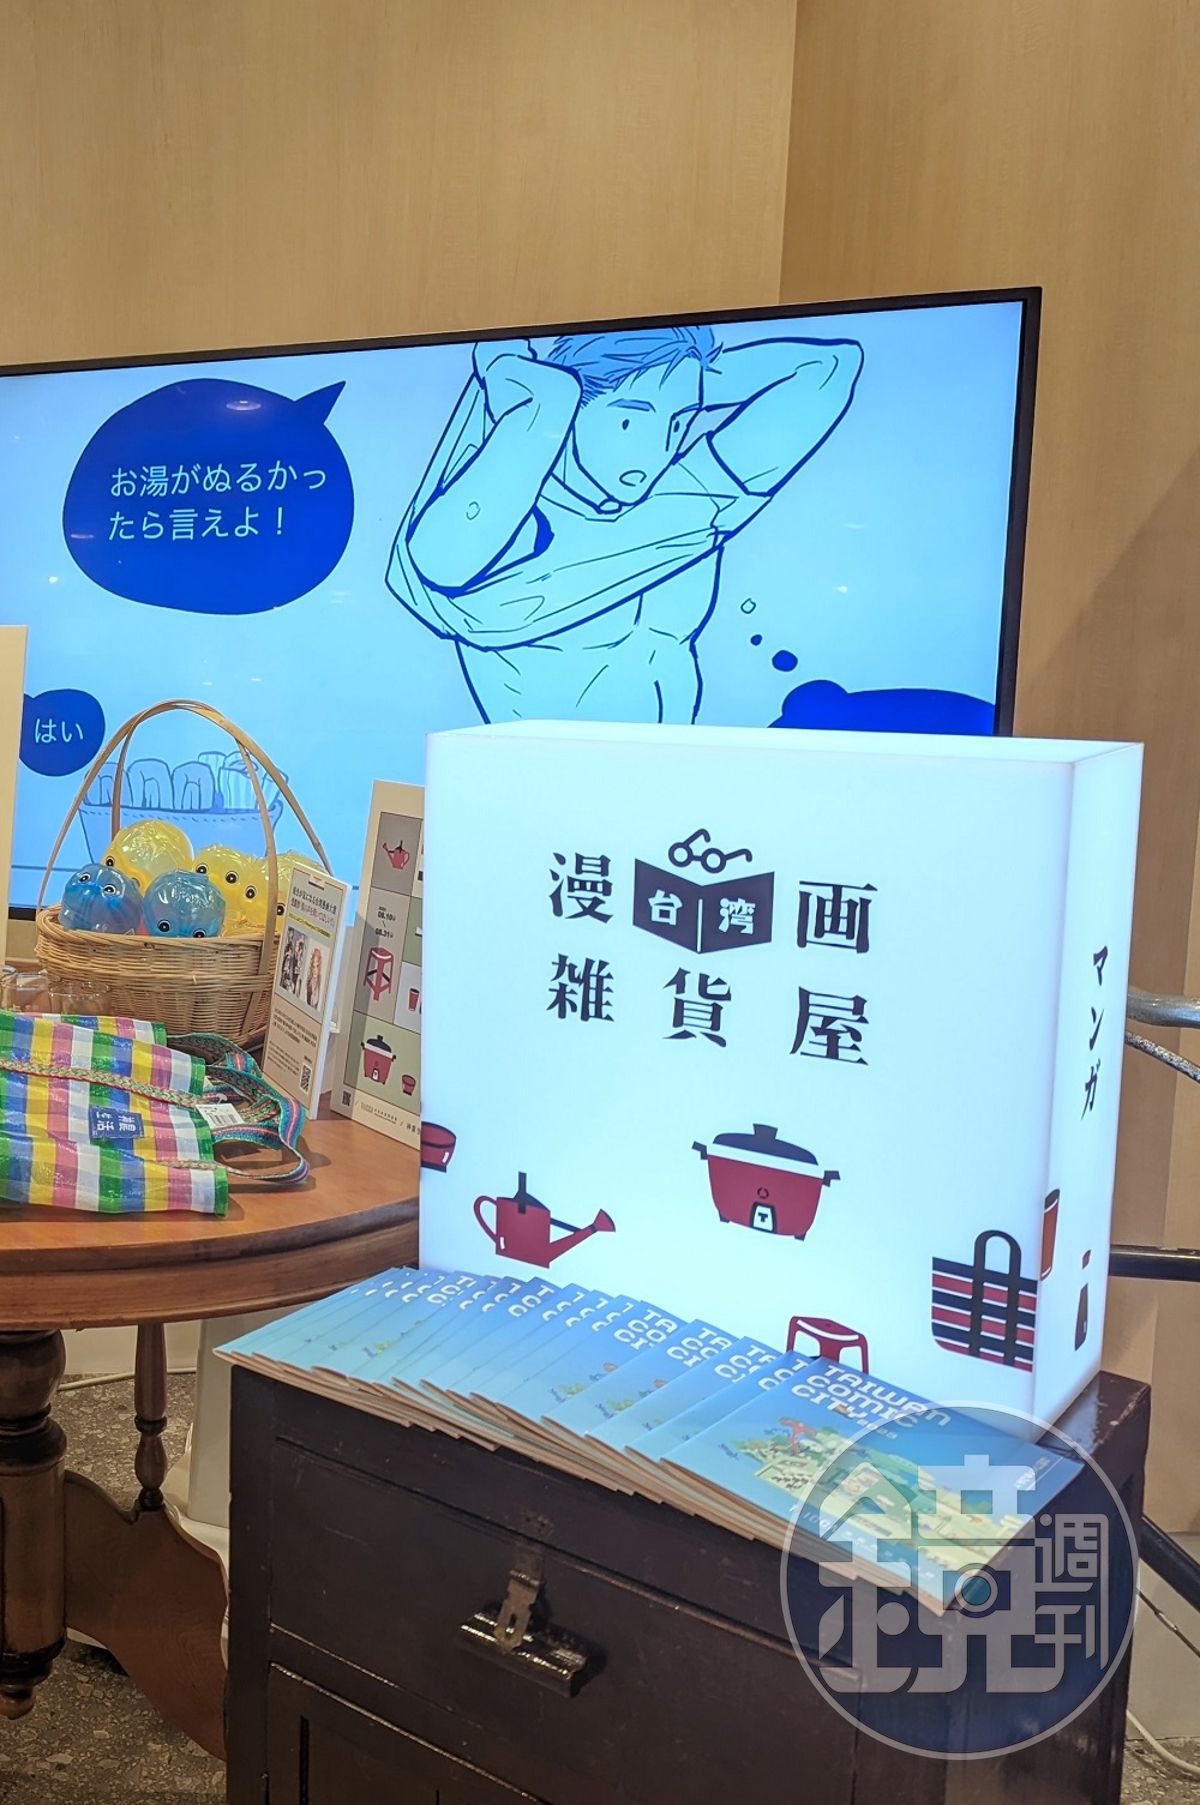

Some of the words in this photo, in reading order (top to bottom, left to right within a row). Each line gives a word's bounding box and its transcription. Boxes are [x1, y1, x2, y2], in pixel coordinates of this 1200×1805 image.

[109, 460, 327, 498] お湯がぬるかっ
[108, 507, 284, 542] たら言えよ！
[34, 717, 85, 745] はい
[648, 889, 756, 935] 台湾
[1081, 945, 1108, 1121] マンガ
[791, 1384, 868, 1418] CITY
[806, 1375, 918, 1428] COMIC
[824, 1365, 951, 1426] TAIWAN
